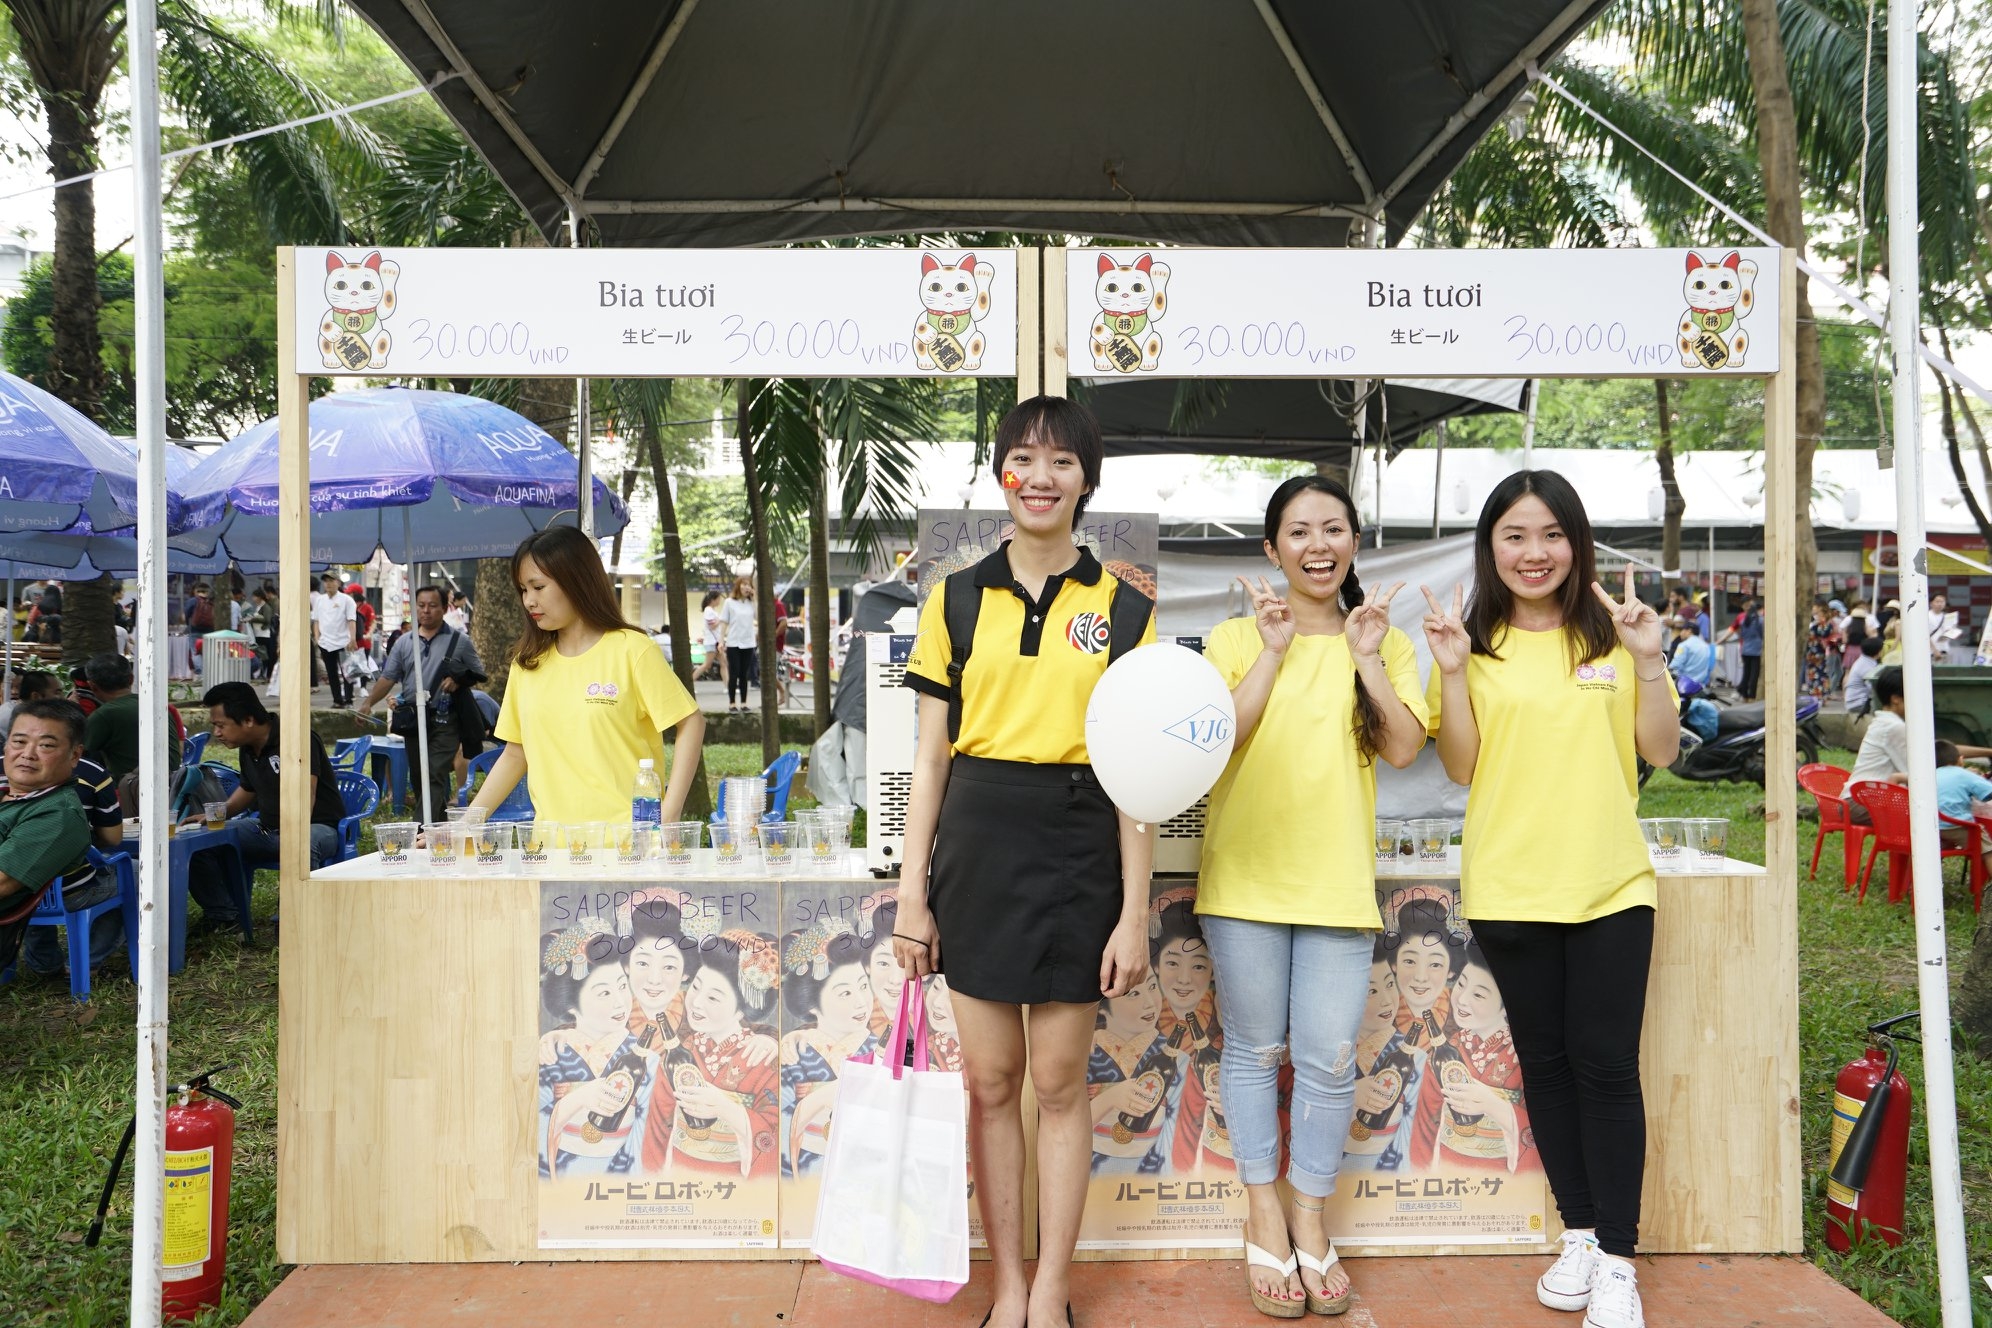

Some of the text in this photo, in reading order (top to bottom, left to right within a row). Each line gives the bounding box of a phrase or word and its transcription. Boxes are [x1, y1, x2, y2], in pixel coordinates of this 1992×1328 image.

[599, 281, 716, 308] Bia tươi
[1367, 282, 1482, 308] Bia tươi
[622, 327, 692, 345] 生ビール
[1390, 327, 1459, 345] 生ビール
[494, 485, 556, 506] AQUAFINA
[1188, 718, 1228, 744] VJG
[553, 890, 762, 924] SAPPRO BEER
